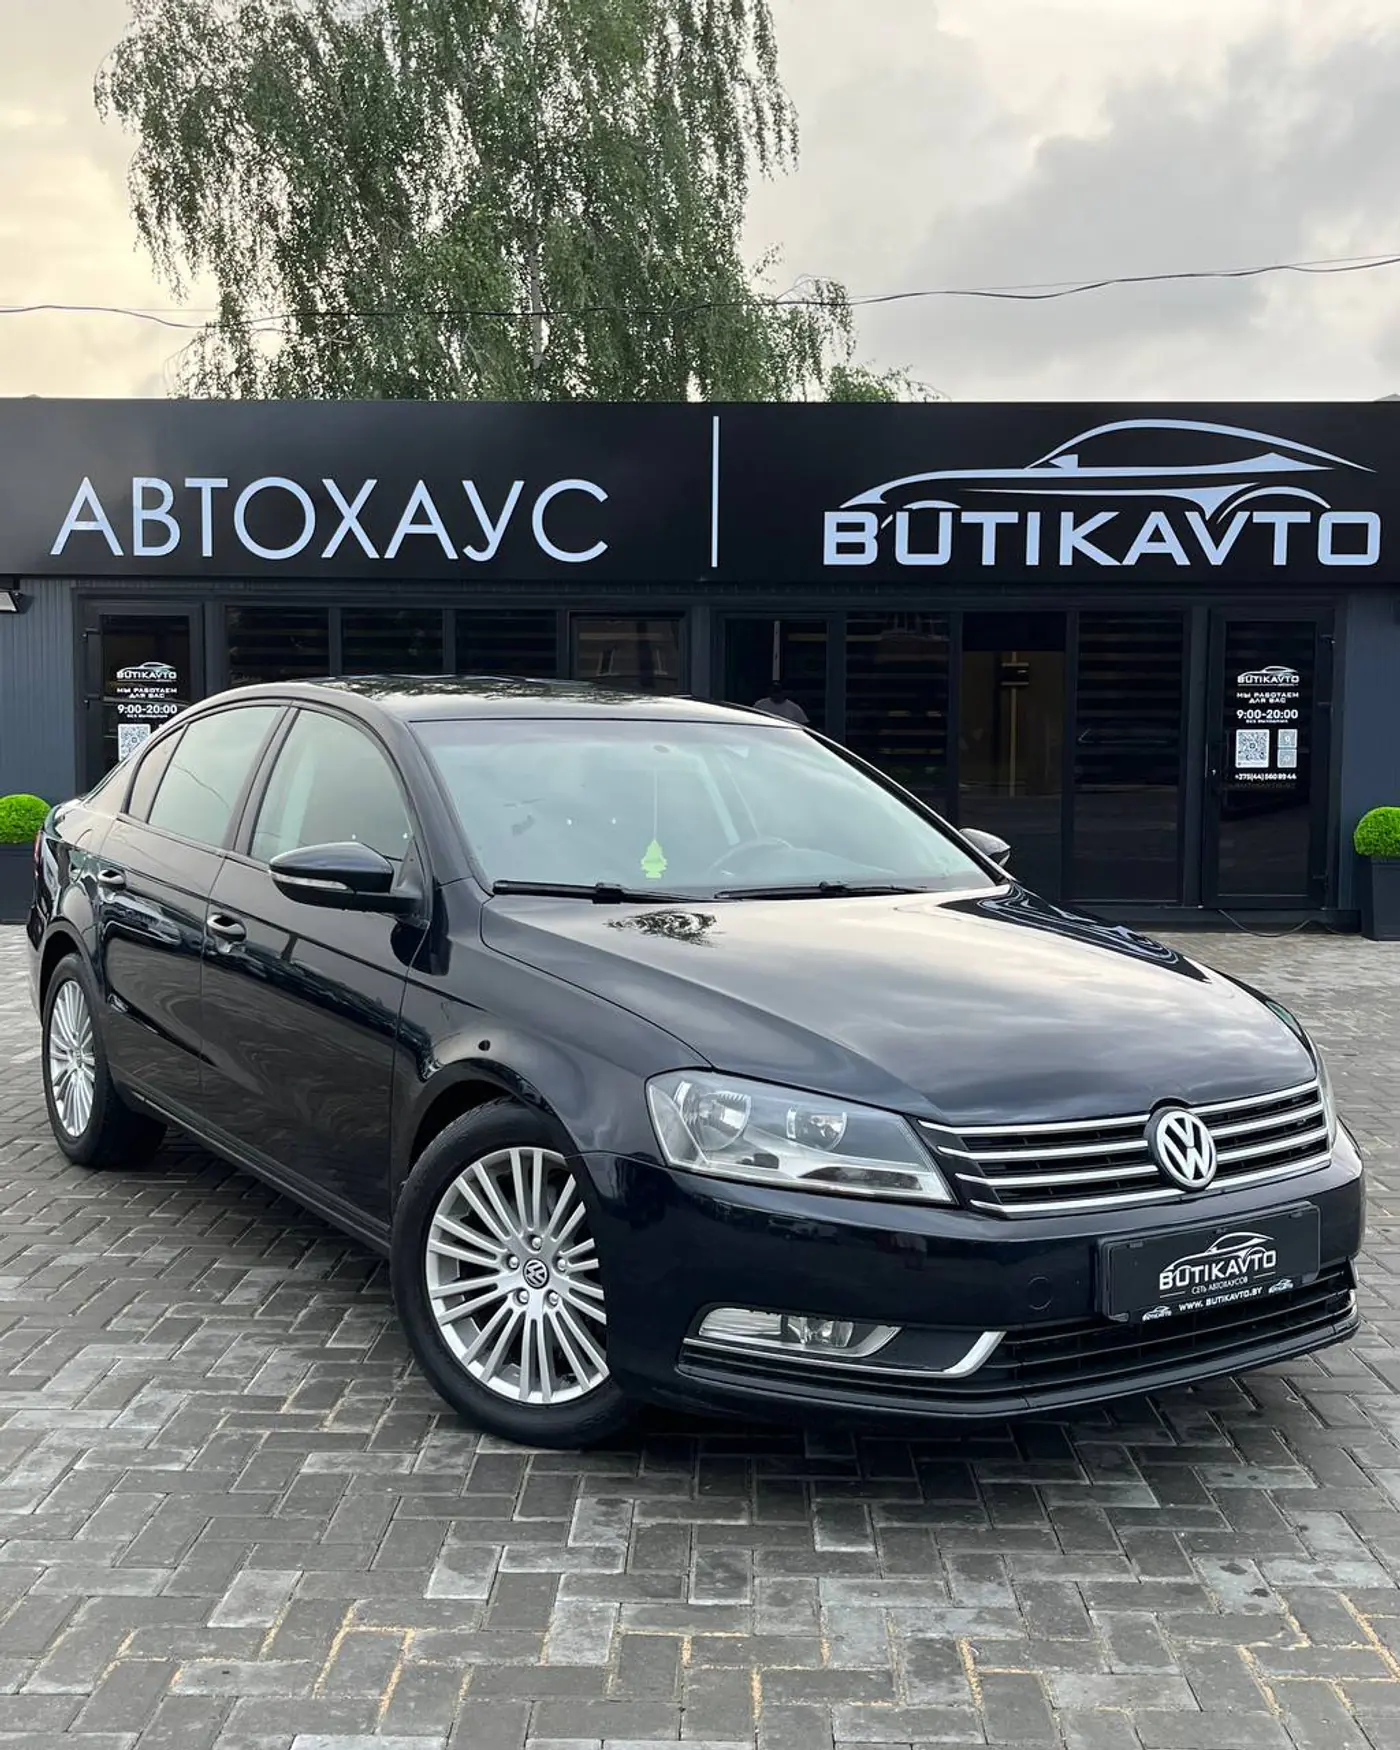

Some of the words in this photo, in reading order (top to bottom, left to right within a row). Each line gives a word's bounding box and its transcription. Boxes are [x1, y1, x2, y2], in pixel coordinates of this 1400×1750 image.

[50, 476, 609, 563] АВТОХАУС
[823, 511, 1381, 566] BUTIKAVTO
[117, 671, 177, 679] BUTIKAVTO
[1237, 675, 1300, 683] BUTIKAVTO
[117, 704, 178, 714] 9:00-20:00
[1236, 709, 1299, 719] 9:00-20:00
[1158, 1250, 1277, 1290] BUTIKAVTO
[1191, 1285, 1207, 1295] СЕТЬ
[1178, 1301, 1204, 1312] WWW.
[1205, 1286, 1263, 1306] BUTIKAVTO.BY
